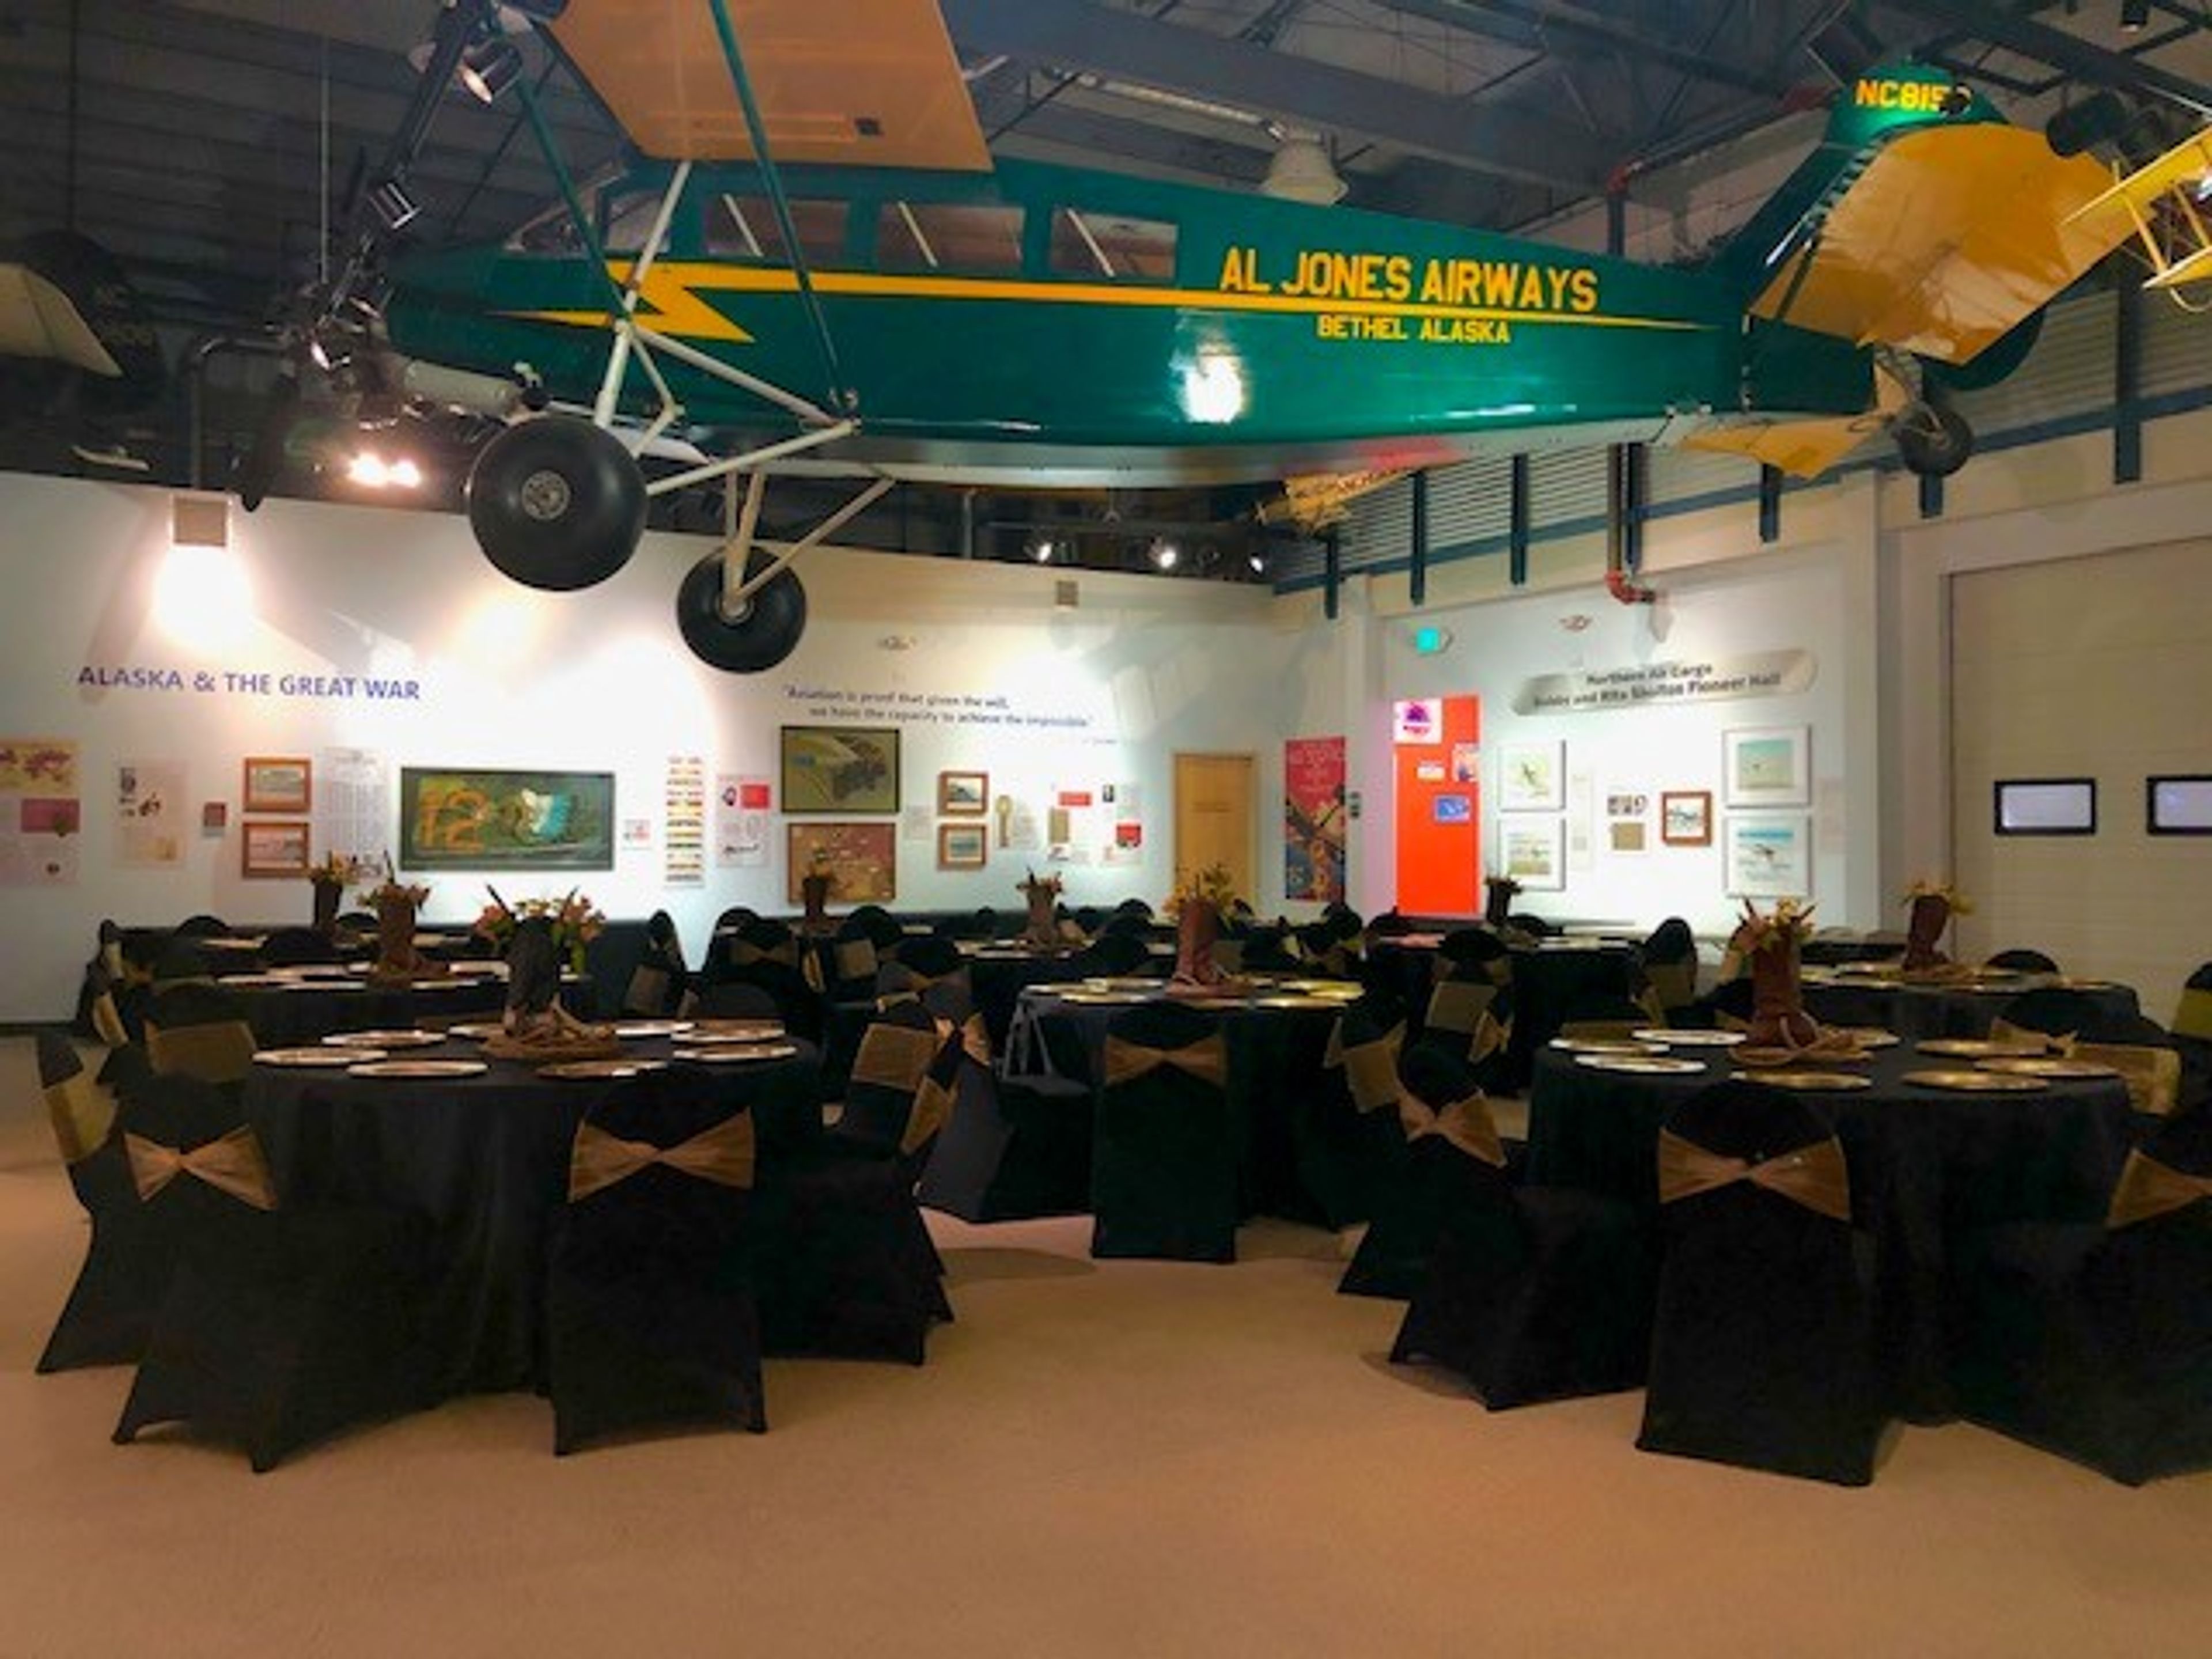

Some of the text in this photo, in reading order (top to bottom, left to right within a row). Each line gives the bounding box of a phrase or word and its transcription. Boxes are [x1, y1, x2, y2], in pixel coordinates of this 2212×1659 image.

[1220, 247, 1599, 312] AL JONES AIRWAYS
[1317, 315, 1512, 344] BETHEL ALASKA
[1671, 664, 1713, 678] Cargo
[78, 666, 420, 700] ALASKA & THE GREAT WAR
[899, 693, 923, 703] that
[864, 707, 885, 718] the
